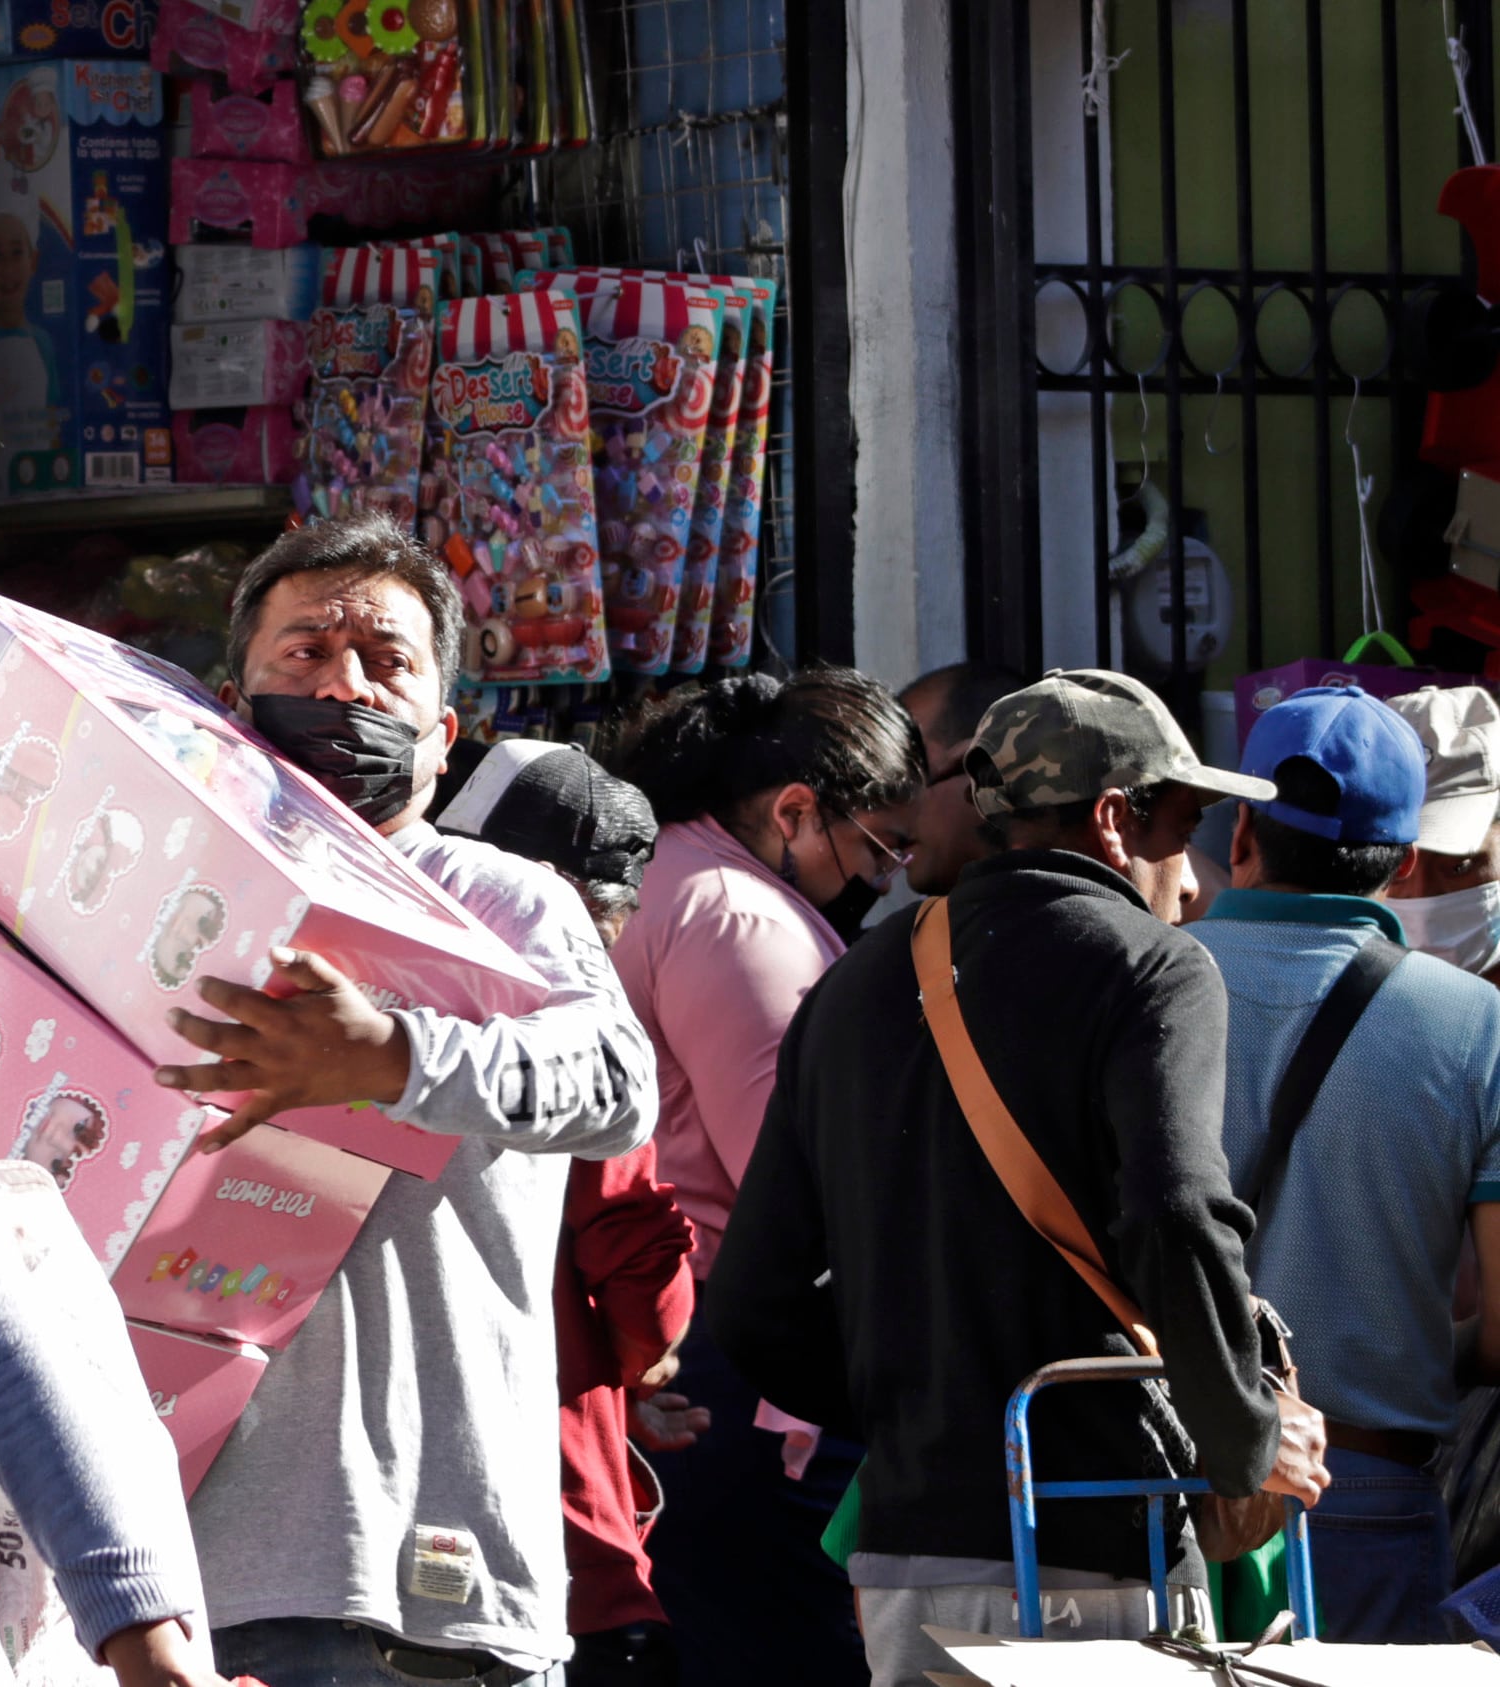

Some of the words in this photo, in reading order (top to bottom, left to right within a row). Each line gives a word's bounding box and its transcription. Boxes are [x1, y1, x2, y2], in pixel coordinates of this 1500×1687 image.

[103, 0, 155, 49] Ch
[583, 347, 656, 382] sert
[449, 364, 533, 407] Dessert
[476, 399, 524, 428] House
[215, 1177, 276, 1208] AMOR
[272, 1191, 316, 1217] POR
[153, 1254, 292, 1303] princesa
[150, 1391, 178, 1416] PO
[1012, 1591, 1082, 1628] LA
